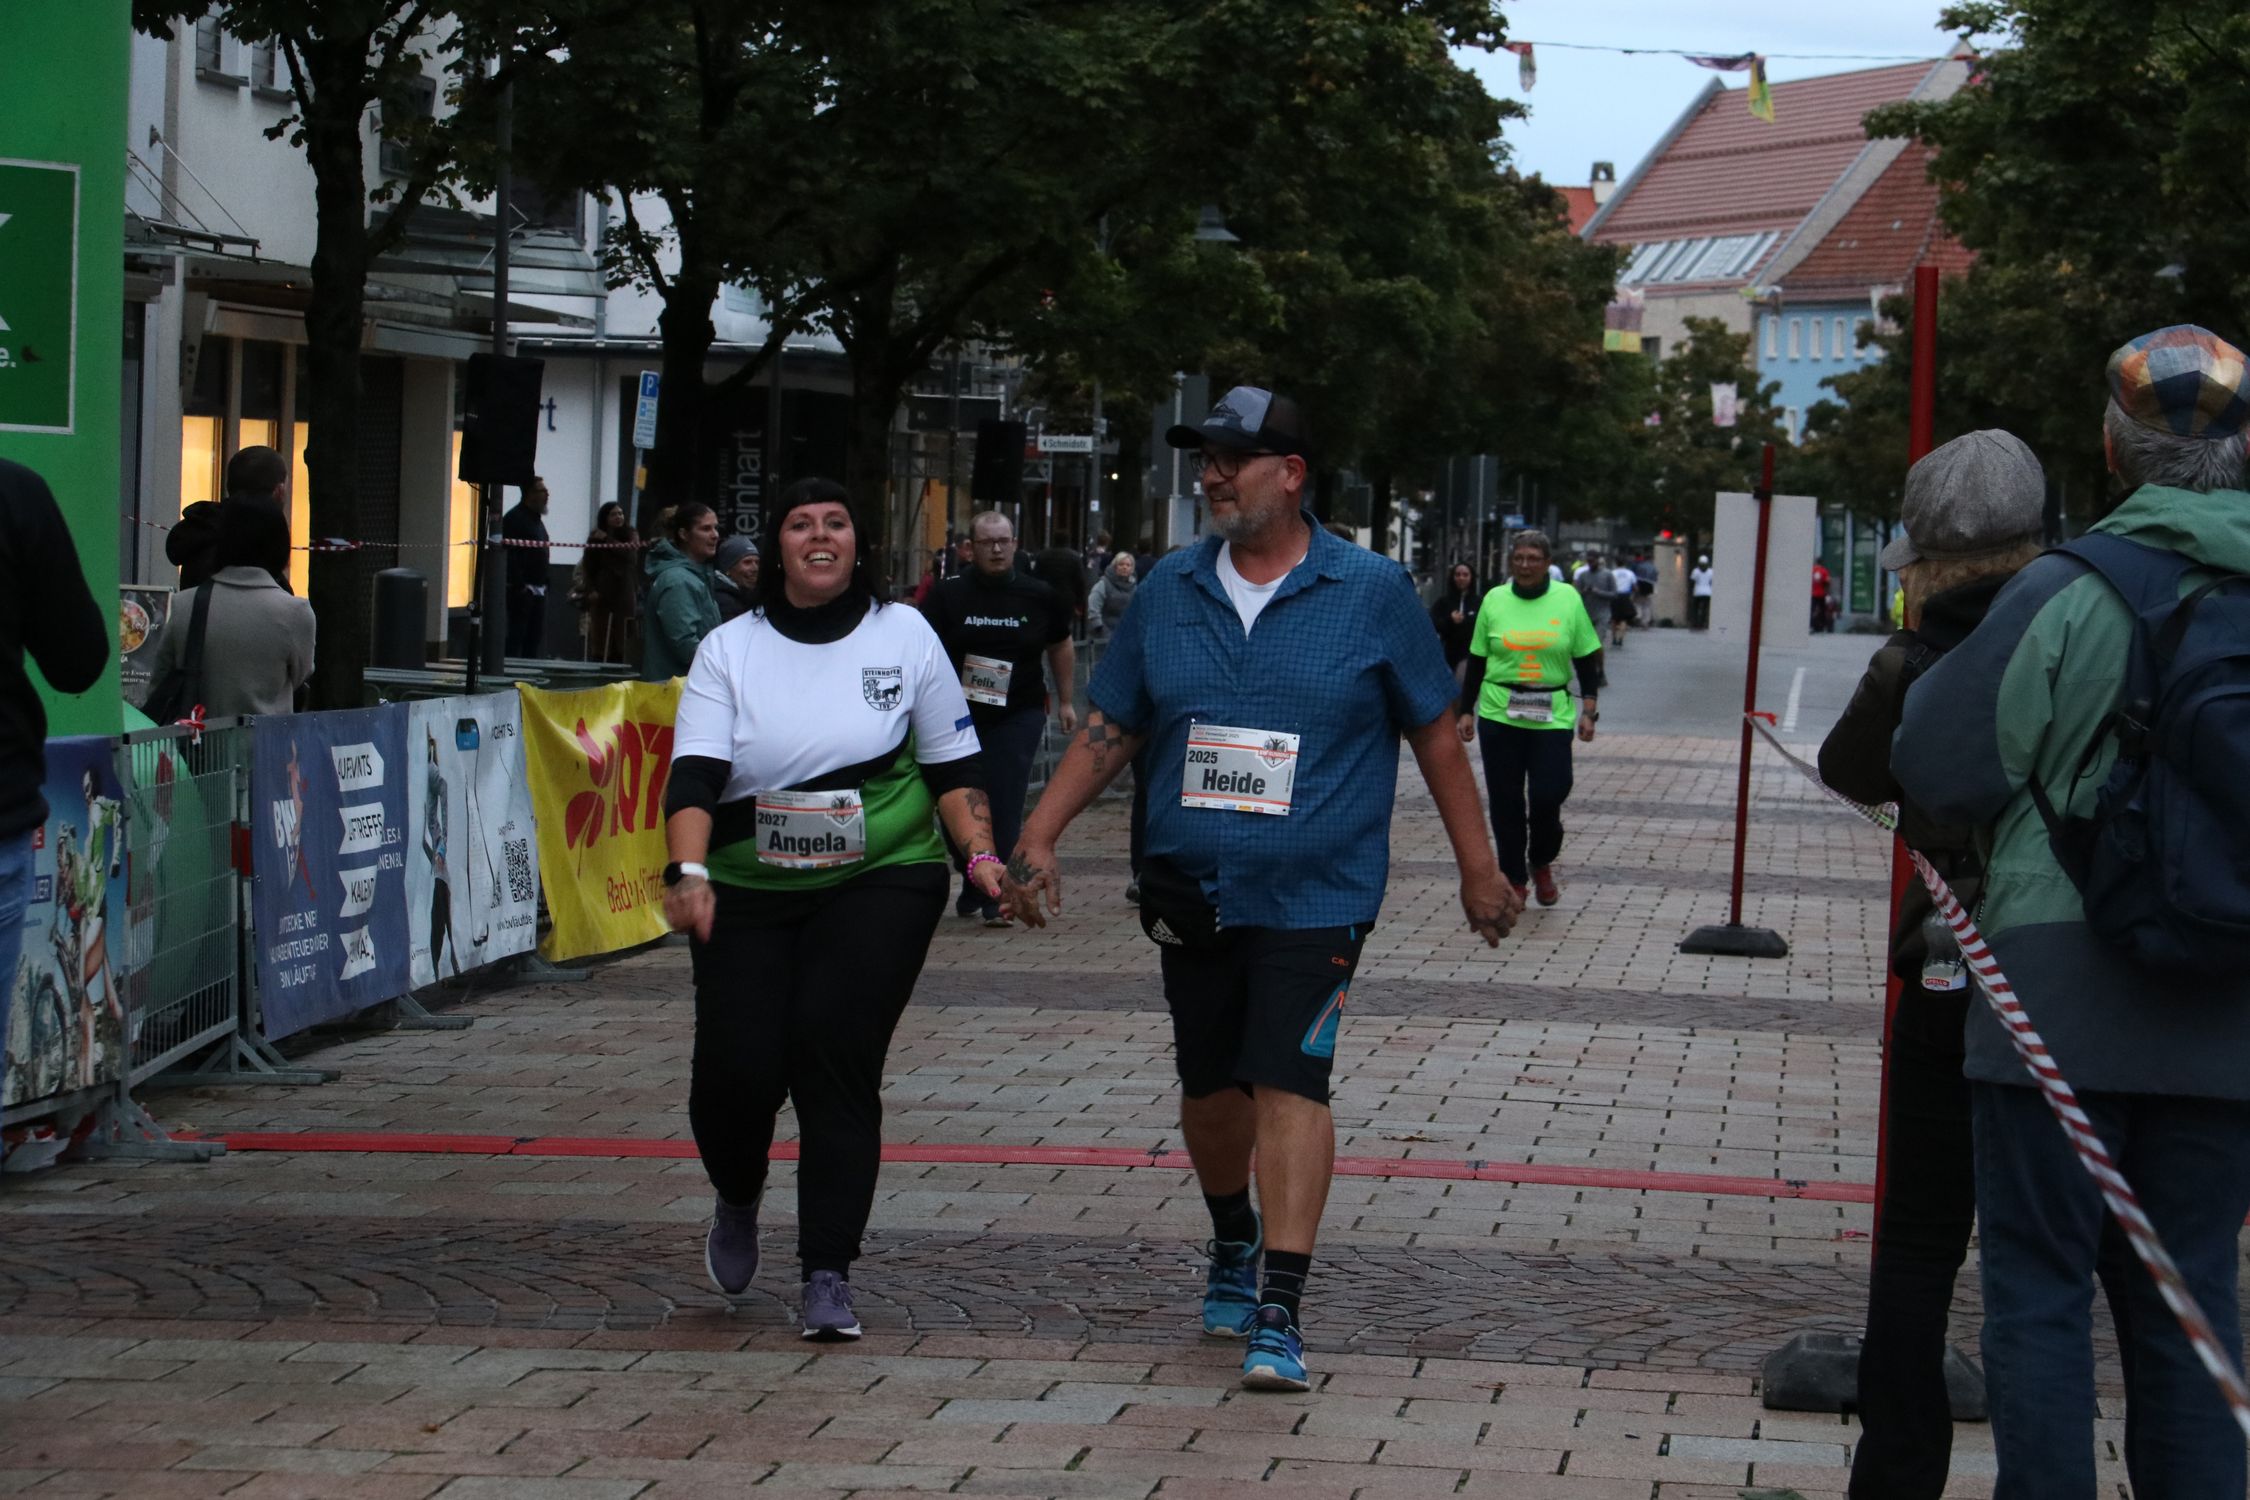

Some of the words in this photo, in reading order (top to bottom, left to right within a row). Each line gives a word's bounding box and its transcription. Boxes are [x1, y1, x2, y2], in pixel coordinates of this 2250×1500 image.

[728, 430, 763, 542] teinhart
[964, 616, 1020, 628] Alphartis
[971, 675, 997, 689] Felix
[1187, 750, 1218, 765] 2025
[1202, 768, 1267, 796] Heide
[758, 813, 788, 827] 2027
[768, 831, 847, 857] Angela
